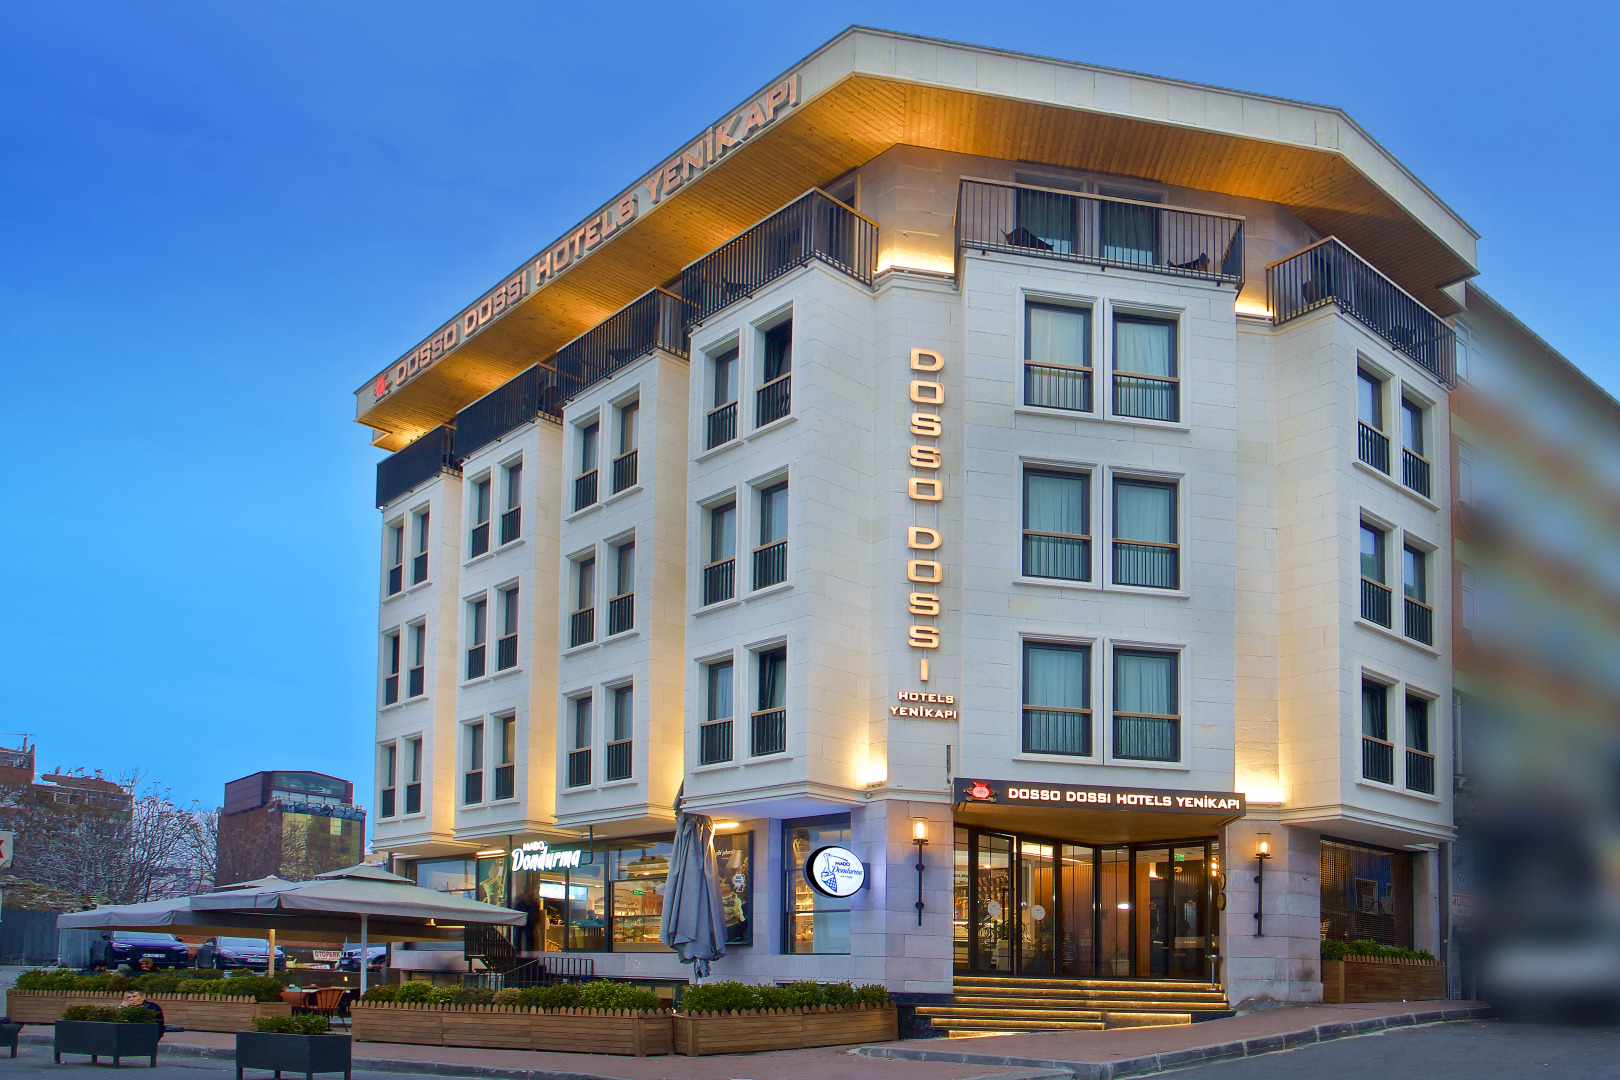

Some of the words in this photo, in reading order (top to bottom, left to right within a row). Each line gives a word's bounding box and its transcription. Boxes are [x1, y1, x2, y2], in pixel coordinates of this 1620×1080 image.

[395, 323, 460, 387] DOSSO
[463, 269, 531, 338] DOSSI
[534, 192, 638, 286] HOTELS
[644, 73, 800, 204] YENİKAPI
[908, 346, 945, 501] DOSSO
[907, 525, 943, 682] DOSSI
[898, 691, 955, 705] HOTELS
[890, 705, 958, 721] YENİKAPI
[1008, 787, 1061, 801] DOSSO
[1066, 791, 1111, 804] DOSSI
[1117, 794, 1172, 807] HOTELS
[1176, 795, 1240, 810] YENİKAPI
[511, 845, 582, 872] Dondurma
[831, 865, 863, 876] Dondurma
[314, 950, 341, 958] OTOPARK
